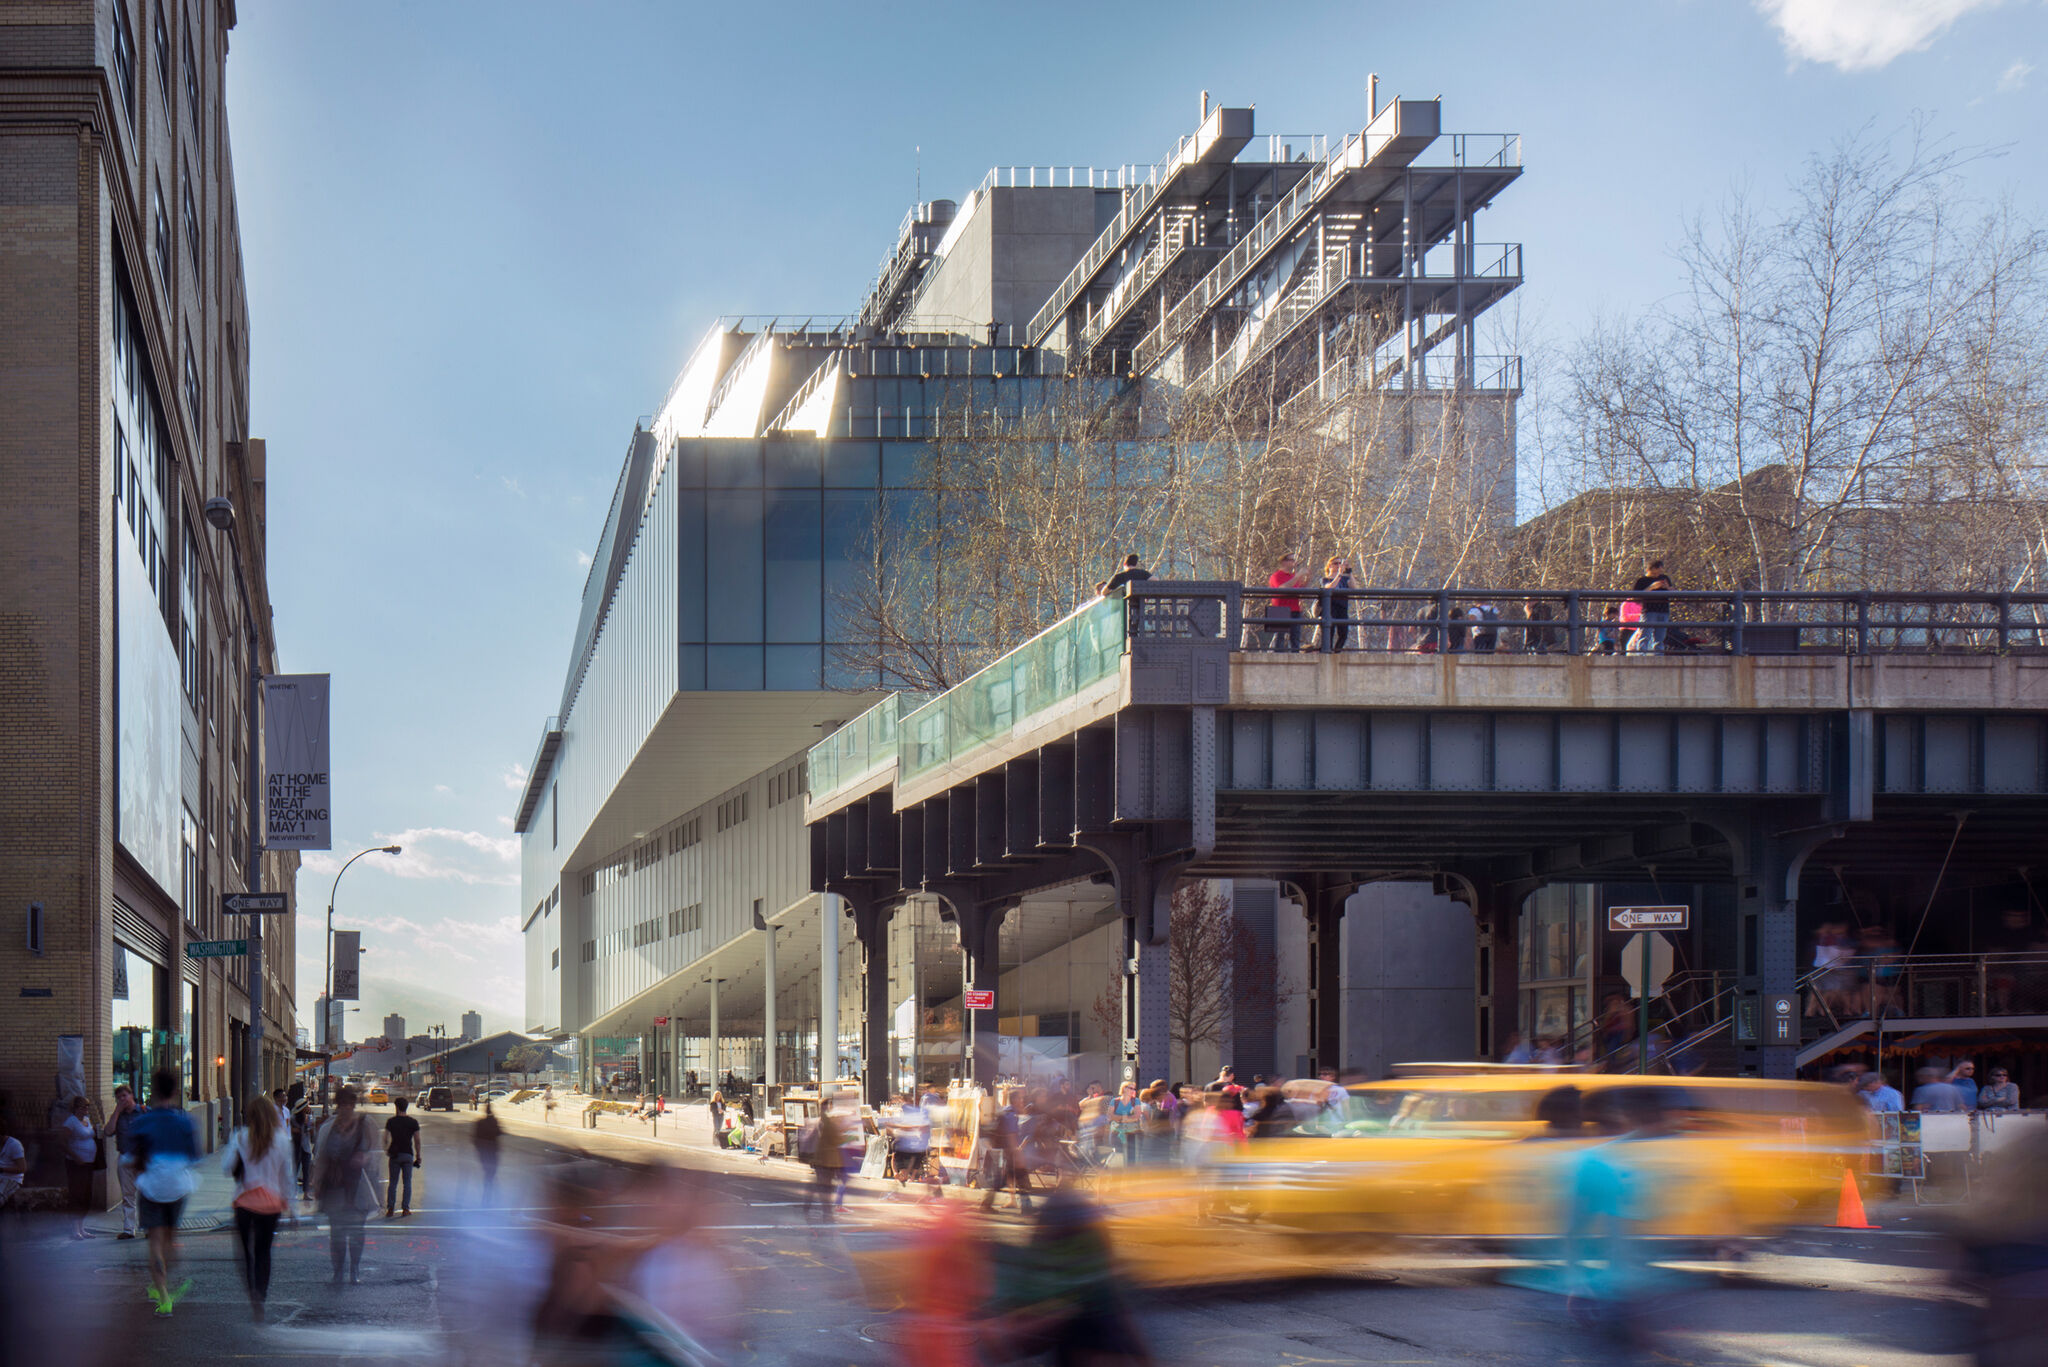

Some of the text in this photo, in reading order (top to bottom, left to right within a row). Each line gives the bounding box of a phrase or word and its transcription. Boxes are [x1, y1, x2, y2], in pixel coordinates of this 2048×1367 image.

[268, 773, 328, 785] AT HOME
[268, 786, 311, 797] IN THE
[268, 797, 305, 809] MEAT
[268, 808, 328, 821] PACKING
[268, 821, 306, 832] MAY 1
[231, 899, 279, 908] ONE WAY
[1621, 913, 1677, 923] ONE WAY
[189, 942, 237, 956] WASHINGTON
